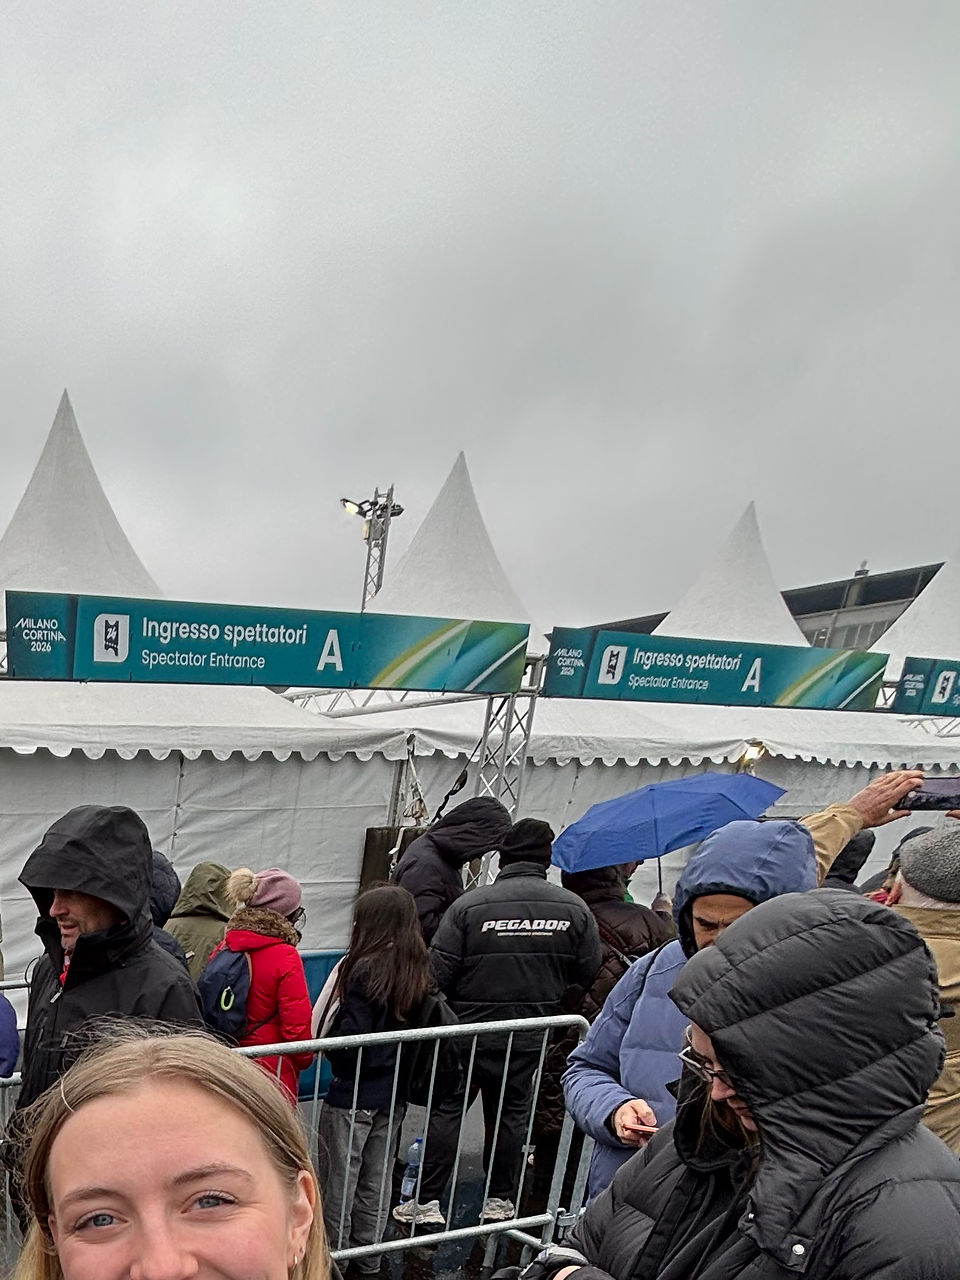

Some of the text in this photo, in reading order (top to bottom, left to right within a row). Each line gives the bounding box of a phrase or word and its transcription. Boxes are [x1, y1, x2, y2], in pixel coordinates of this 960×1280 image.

[15, 617, 58, 630] MILANO
[142, 616, 308, 647] Ingresso spettatori
[22, 629, 67, 641] CORTINA
[30, 641, 52, 652] 2026
[316, 629, 344, 672] A
[553, 647, 583, 657] MILANO
[141, 649, 265, 669] Spectator Entrance
[633, 648, 743, 672] Ingresso spettatori
[628, 673, 709, 690] Spectator Entrance
[740, 657, 763, 693] A
[481, 919, 571, 932] PEGADOR
